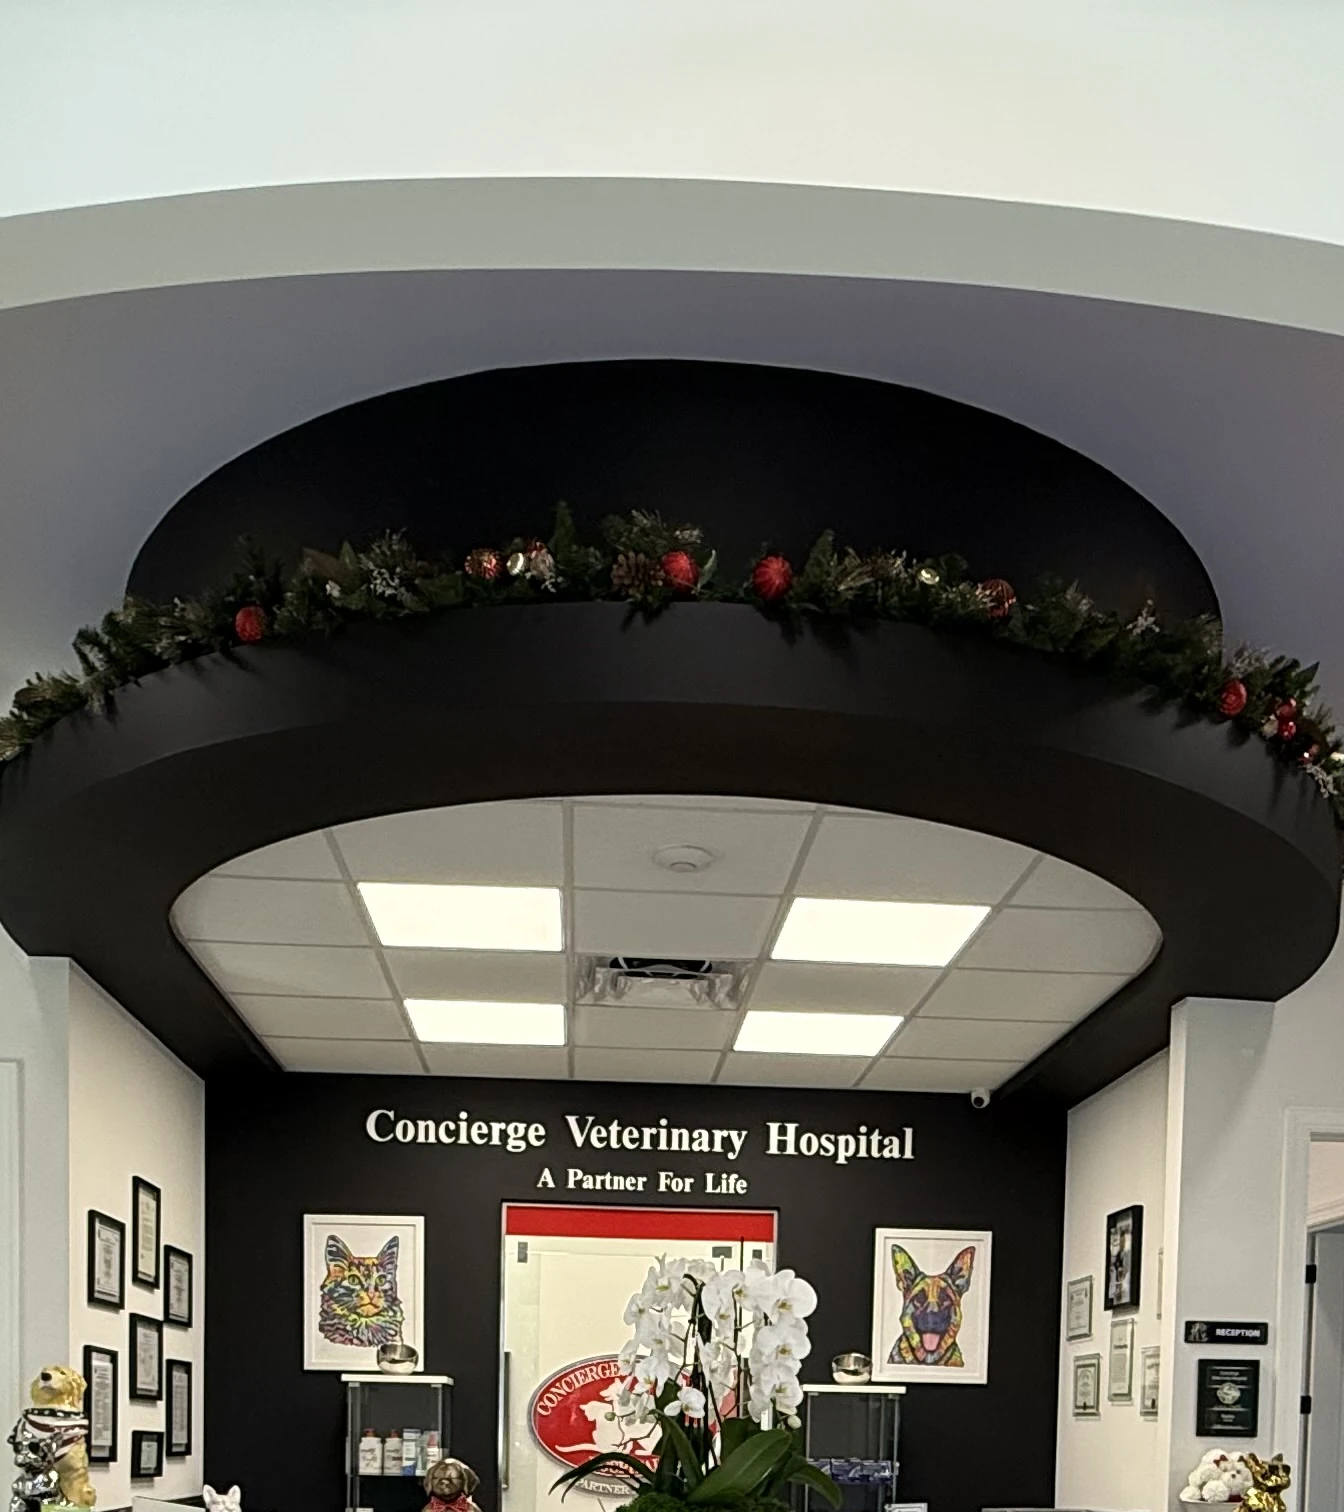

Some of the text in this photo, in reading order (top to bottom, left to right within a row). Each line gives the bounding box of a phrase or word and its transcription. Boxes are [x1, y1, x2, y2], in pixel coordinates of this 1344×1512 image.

[365, 1109, 915, 1165] Concierge Veterinary Hospital
[537, 1167, 748, 1195] A Partner For Life
[1215, 1328, 1261, 1338] RECEPTION
[536, 1361, 622, 1416] CONCIERGE
[575, 1479, 630, 1494] PARTNER
